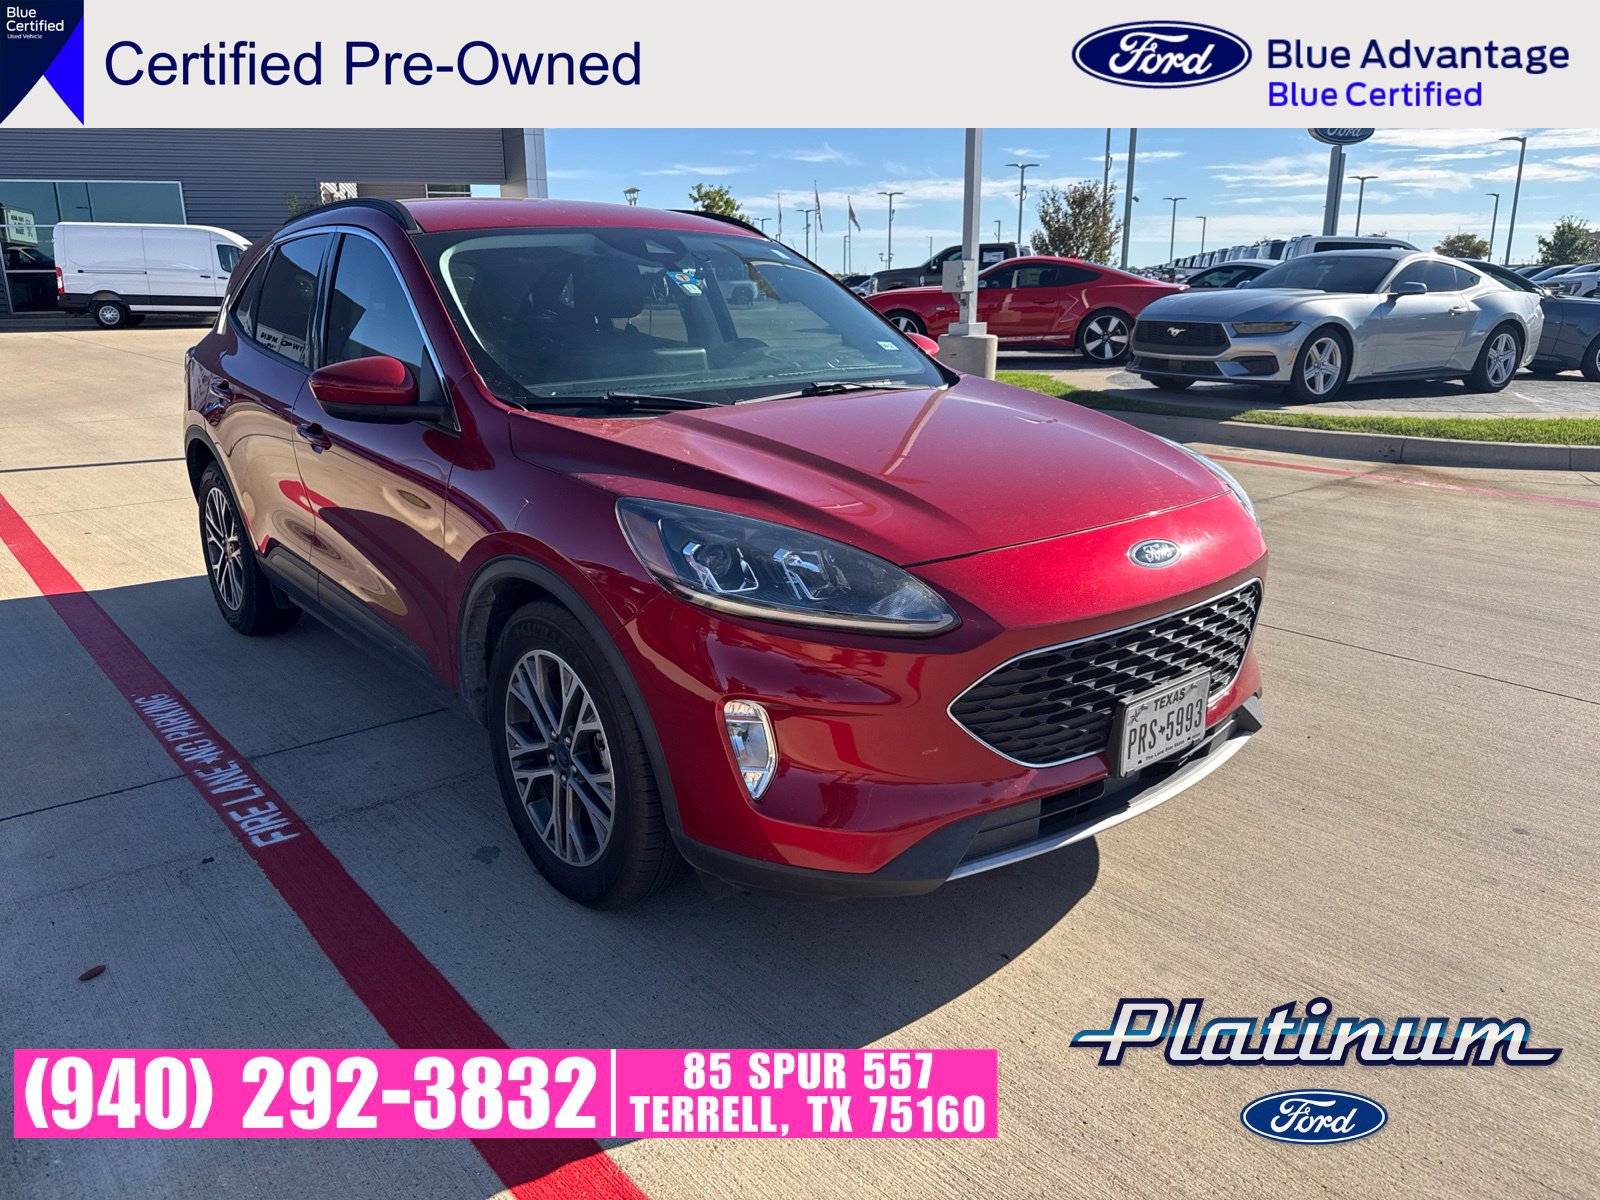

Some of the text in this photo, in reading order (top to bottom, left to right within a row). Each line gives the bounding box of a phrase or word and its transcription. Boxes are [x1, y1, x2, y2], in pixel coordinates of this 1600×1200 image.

[133, 693, 206, 742] PARKING
[1154, 687, 1186, 711] TEXAS
[193, 760, 266, 807] LANE
[228, 801, 301, 848] FIRE
